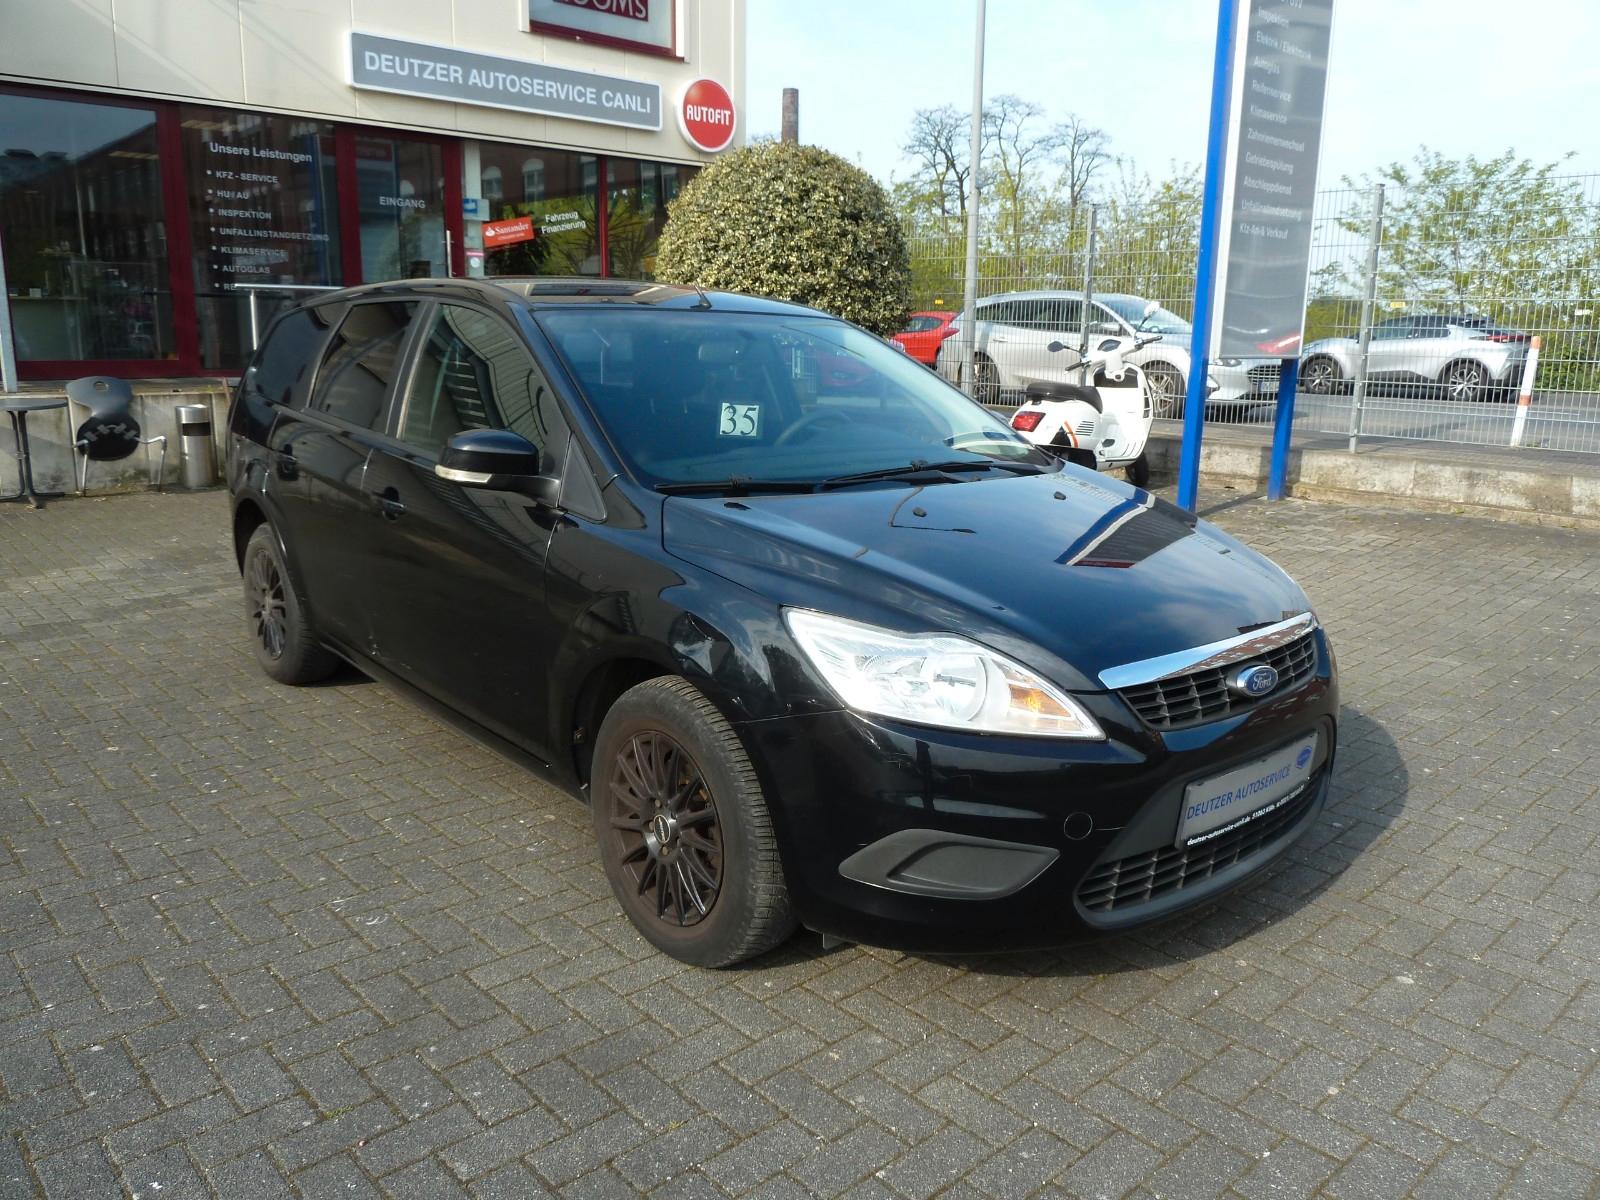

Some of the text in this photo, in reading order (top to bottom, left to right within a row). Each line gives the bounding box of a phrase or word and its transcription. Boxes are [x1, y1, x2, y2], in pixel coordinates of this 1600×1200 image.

[364, 51, 651, 114] DEUTZER AUTOSERVICE CANLI
[686, 104, 731, 126] AUTOFIT
[210, 142, 313, 163] Unsere Leistungen
[215, 170, 233, 180] KFZ
[240, 173, 278, 184] SERVICE
[379, 196, 426, 209] EINGANG
[218, 208, 272, 220] INSPEKTION
[545, 211, 579, 223] Fahrzeug
[541, 220, 586, 235] Finanzierung
[221, 246, 287, 257] KLIMASERVICE
[222, 264, 271, 274] AUTOGLAS
[721, 405, 757, 436] 35
[1253, 672, 1272, 690] Ford
[1187, 791, 1233, 820] DEUTZER
[1234, 765, 1291, 801] AUTOSERVICE
